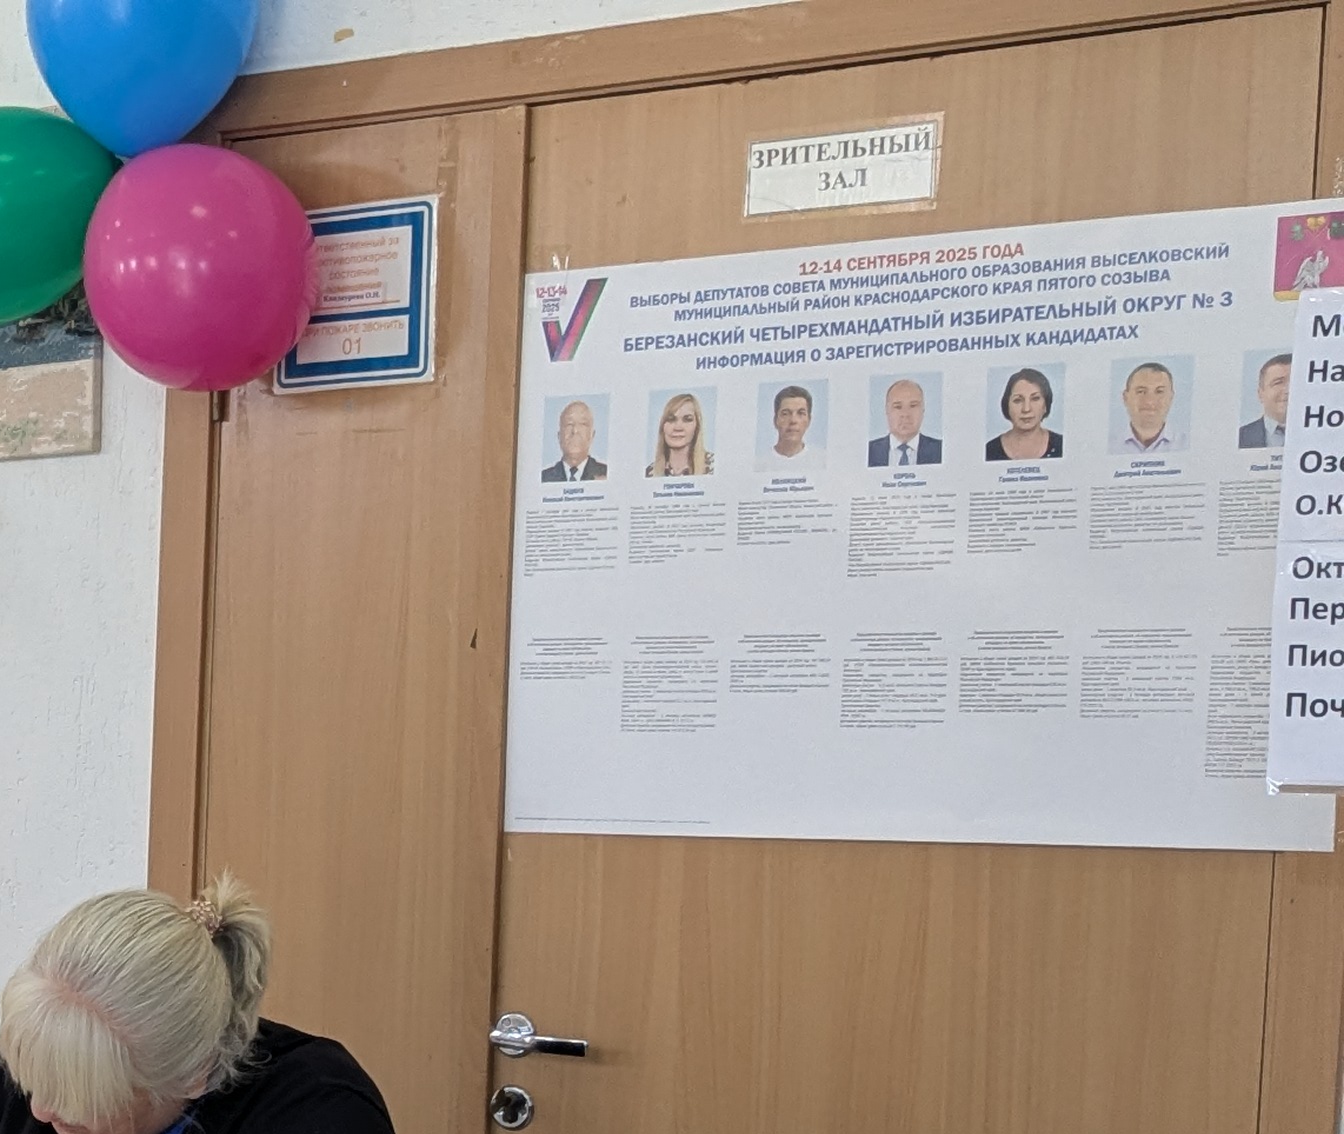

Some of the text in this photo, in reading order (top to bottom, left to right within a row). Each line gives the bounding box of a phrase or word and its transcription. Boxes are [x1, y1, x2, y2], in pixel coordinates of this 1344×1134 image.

[752, 127, 932, 169] ЗРИТЕЛЬНЫЙ
[817, 168, 868, 192] ЗАЛ
[629, 242, 1230, 309] ВЫБОРЫ ДЕПУТАТОВ СОВЕТА МУНИЦИПАЛЬНОГО ОБРАЗОВАНИЯ ВЫСЕЛКОВСКИЙ
[799, 242, 1024, 277] 12-14 СЕНТЯБРЯ 2025 ГОДА
[673, 268, 1172, 322] МУНИЦИПАЛЬНЫЙ РАЙОН КРАСНОДАРСКОГО КРАЯ ПЯТОГО СОЗЫВА
[623, 291, 1233, 353] БЕРЕЗАНСКИЙ ЧЕТЫРЕХМАНДАТНЫЙ ИЗБИРАТЕЛЬНЫЙ ОКРУГ № 3
[1312, 314, 1344, 338] М
[341, 337, 362, 356] 01
[696, 324, 1139, 371] ИНФОРМАЦИЯ О ЗАРЕГИСТРИРОВАННЫХ КАНДИДАТАХ
